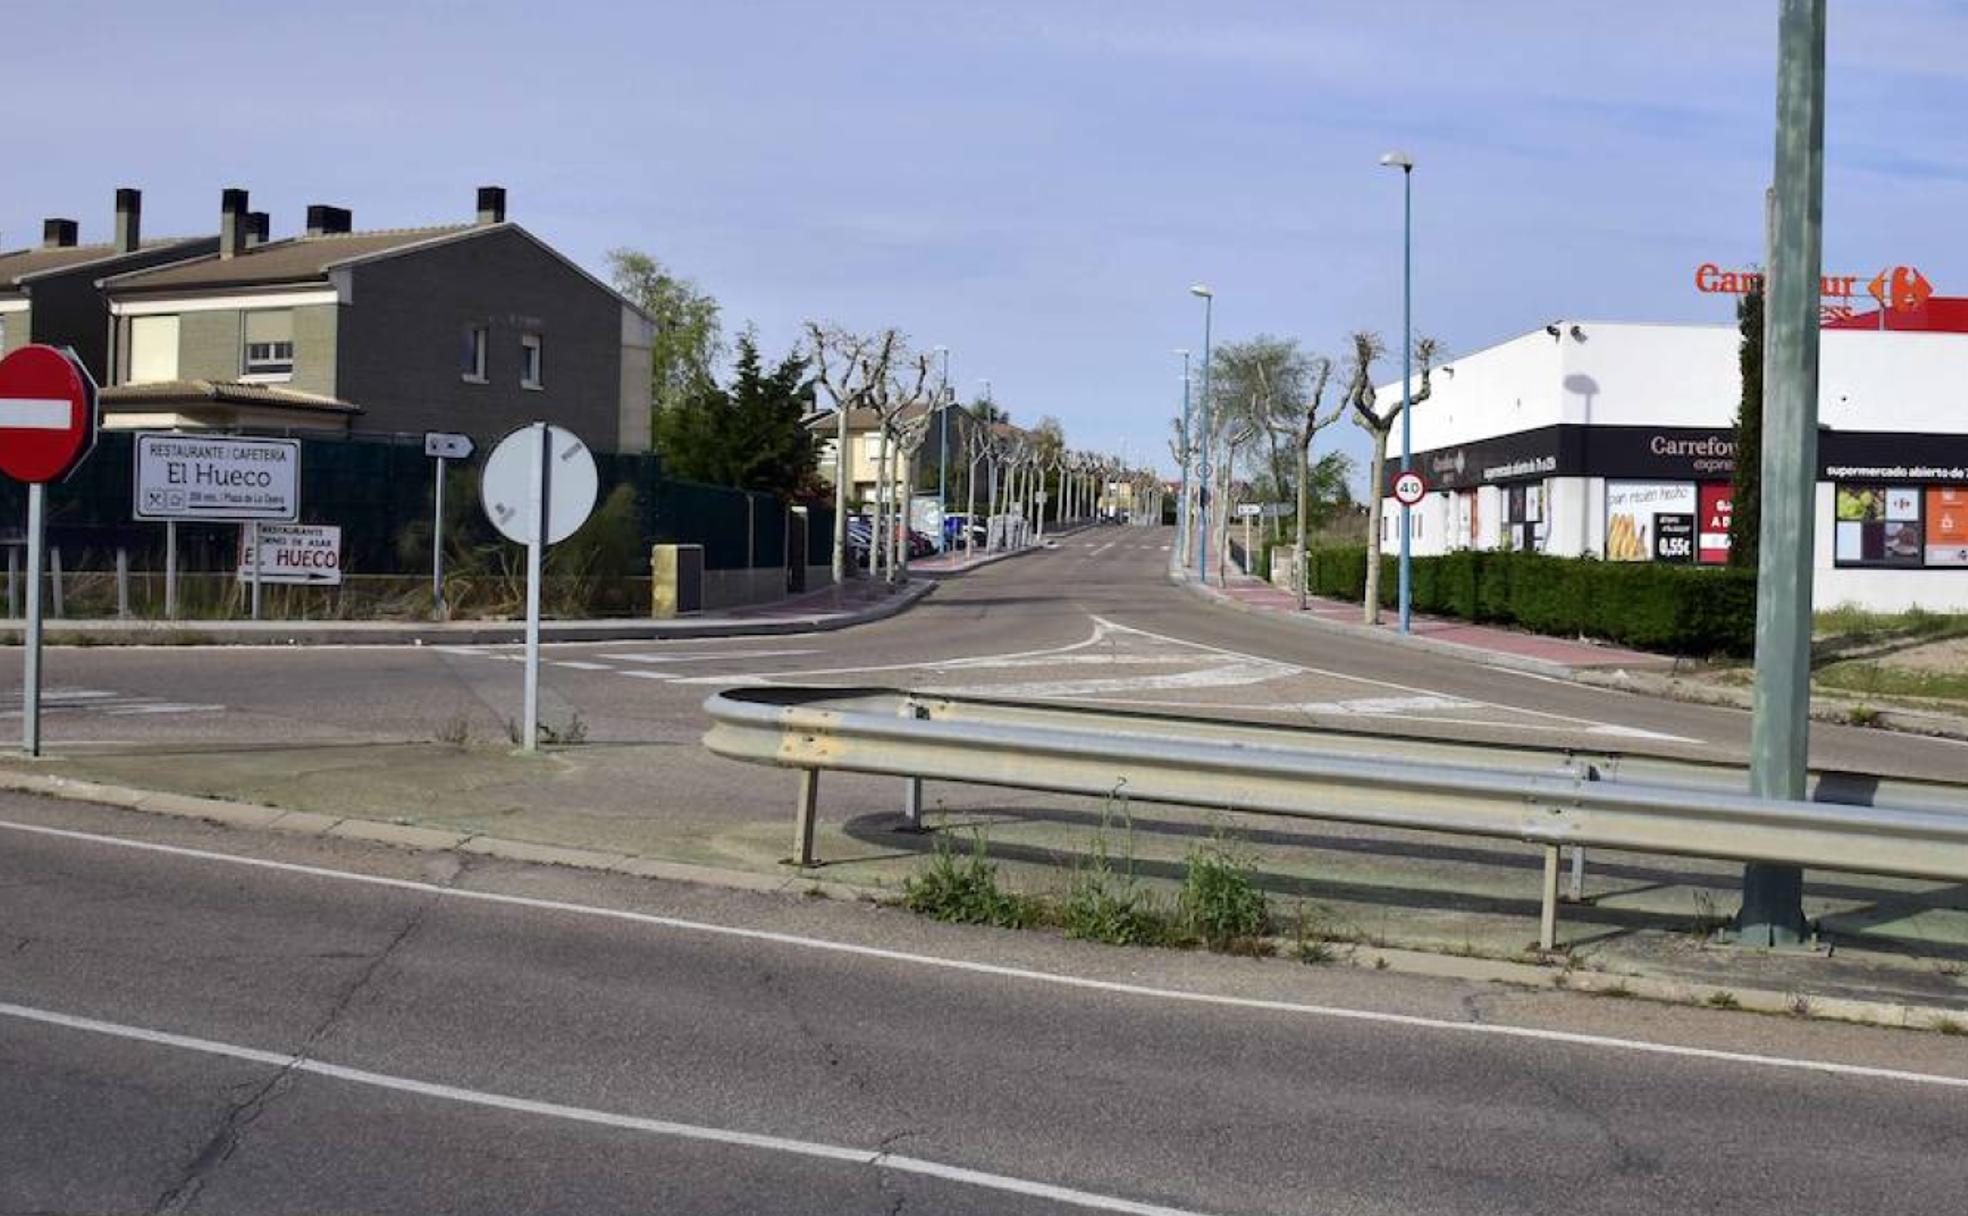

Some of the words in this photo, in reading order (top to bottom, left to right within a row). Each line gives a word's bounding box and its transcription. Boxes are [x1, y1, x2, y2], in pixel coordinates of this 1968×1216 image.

[150, 444, 225, 459] RESTAURANTE
[168, 462, 187, 484] El
[195, 463, 272, 488] Hueco
[1826, 466, 1907, 478] supermercado
[1400, 482, 1420, 494] 40
[276, 549, 338, 568] HUECO
